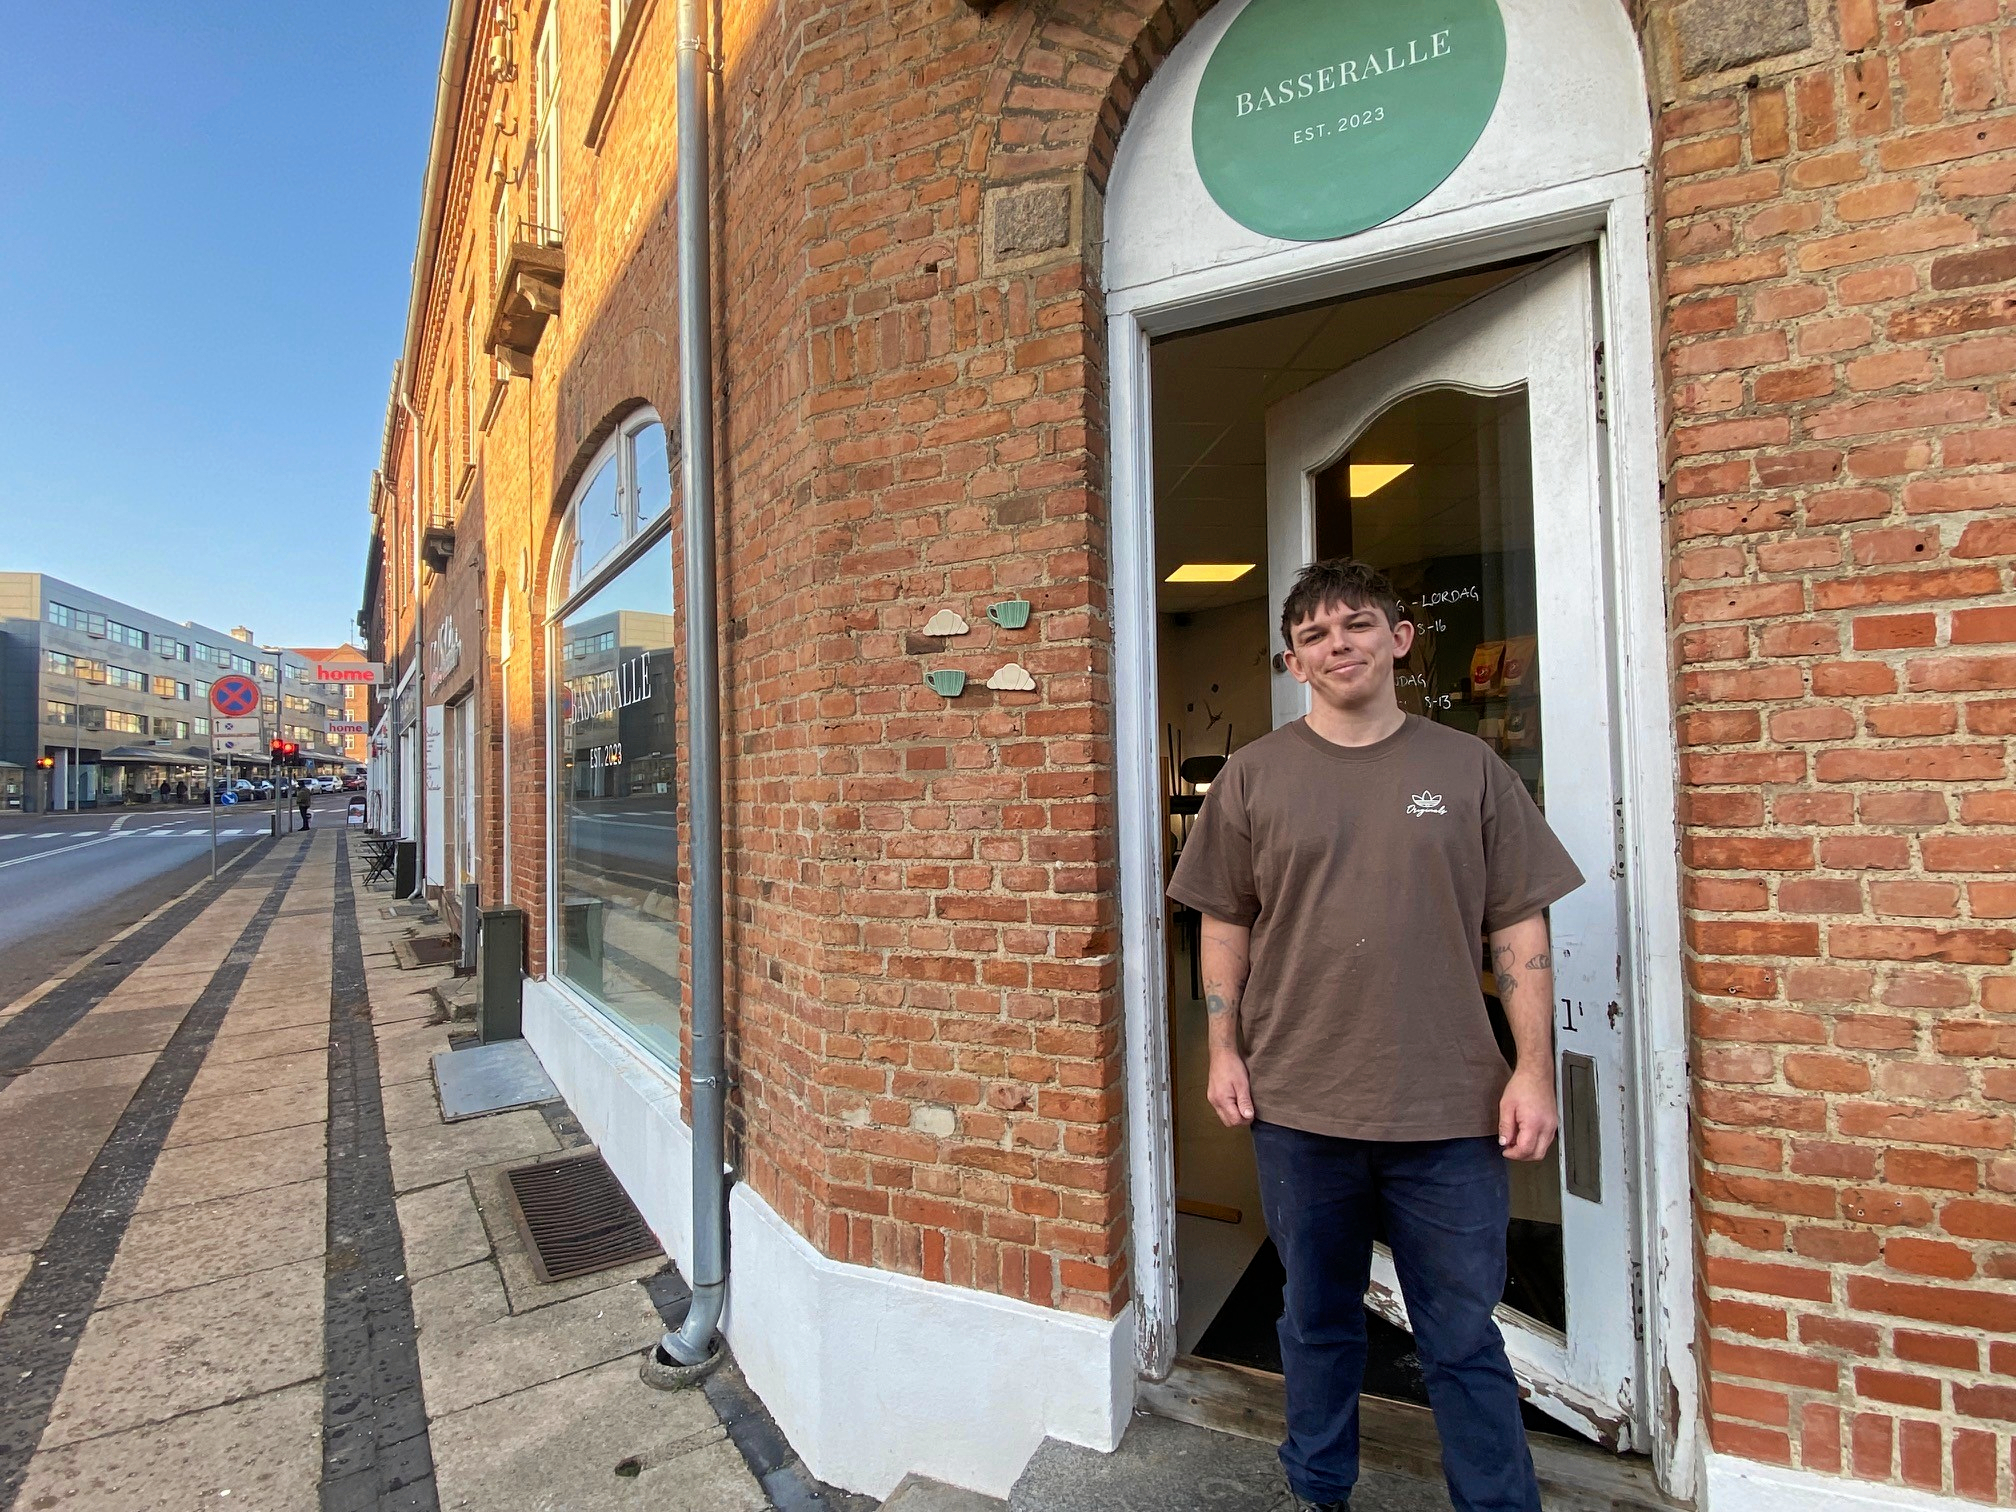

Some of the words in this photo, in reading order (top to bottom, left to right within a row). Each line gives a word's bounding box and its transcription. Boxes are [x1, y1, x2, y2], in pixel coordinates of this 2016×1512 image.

[1235, 29, 1451, 118] BASSERALLE
[1294, 123, 1331, 145] EST.
[1338, 107, 1385, 132] 2023
[317, 665, 375, 681] home
[571, 651, 652, 725] BASSERALLE
[329, 722, 363, 732] home
[590, 746, 603, 768] EST.
[605, 743, 622, 767] 2023
